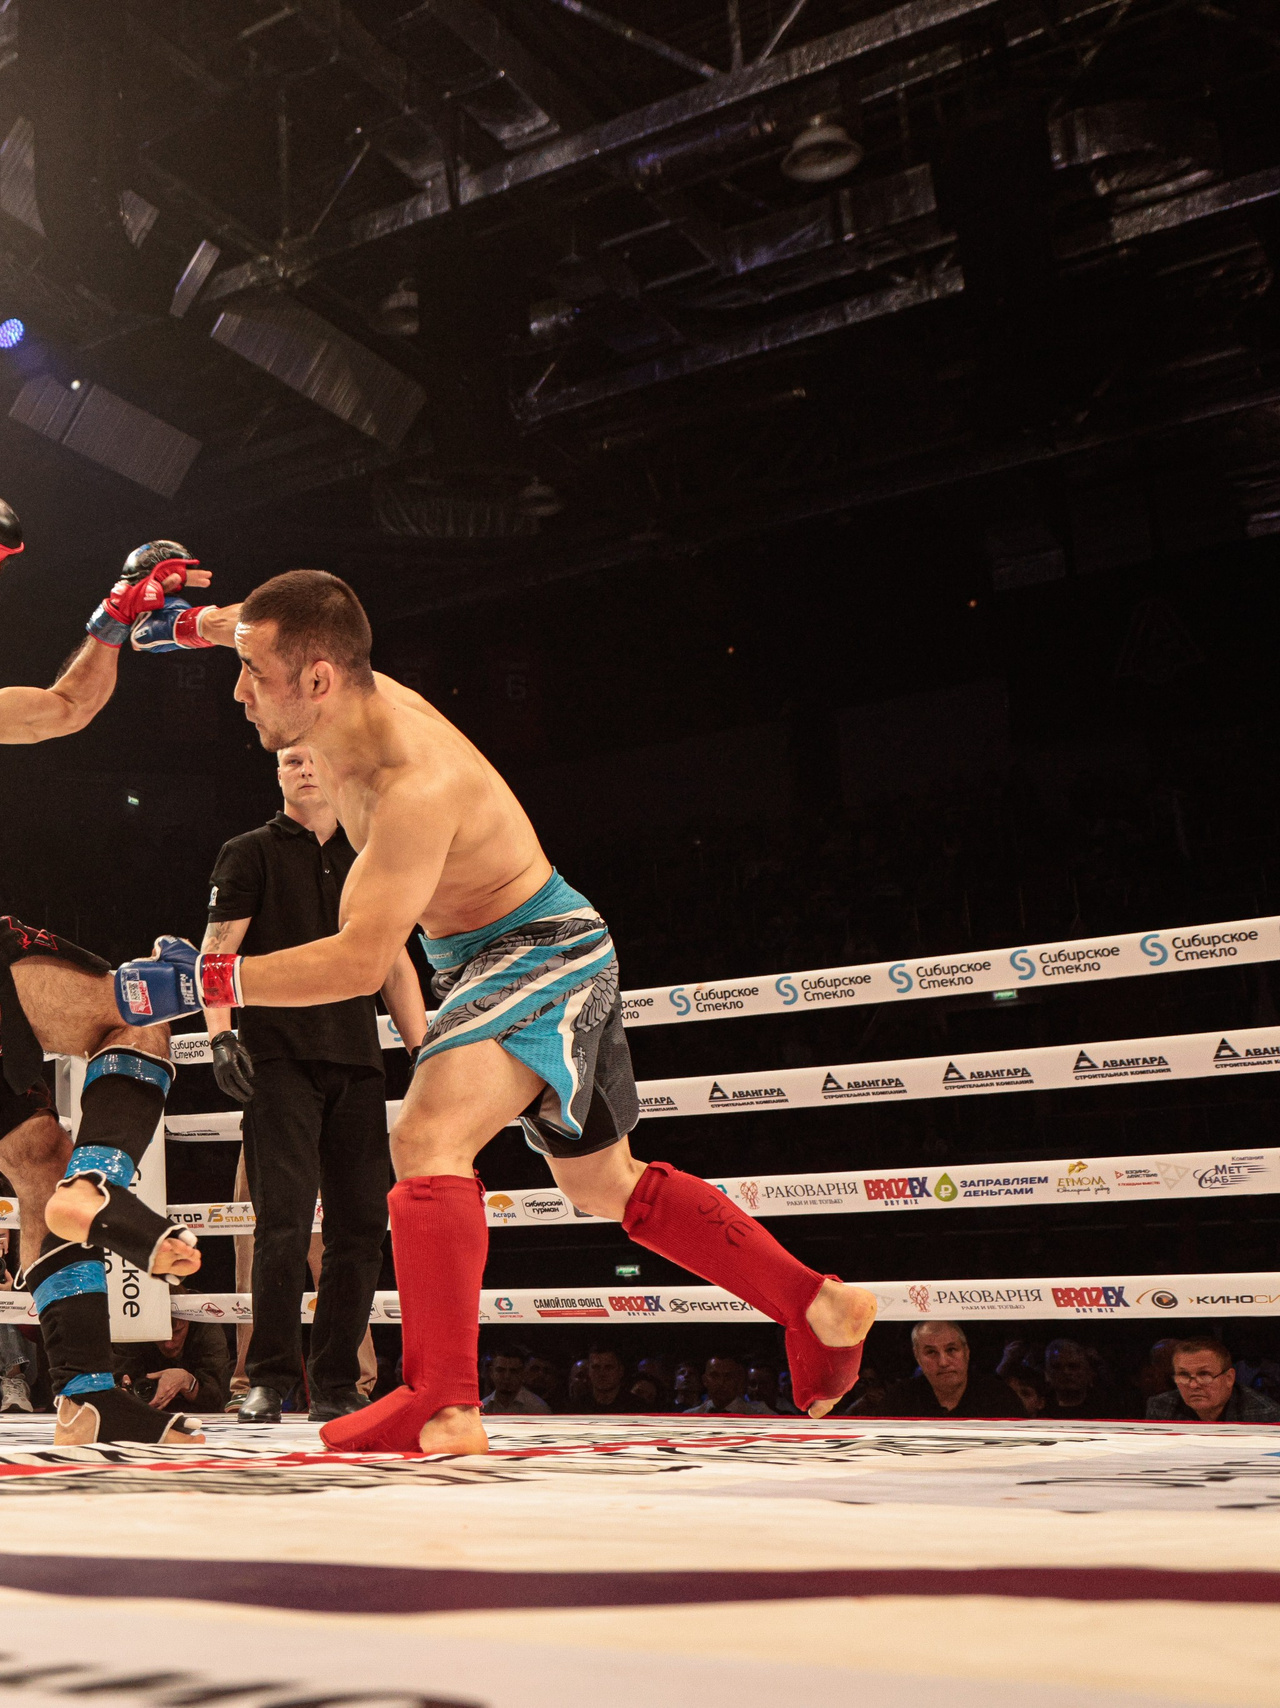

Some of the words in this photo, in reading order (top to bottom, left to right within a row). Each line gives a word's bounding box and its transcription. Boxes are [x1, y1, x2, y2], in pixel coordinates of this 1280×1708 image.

[1172, 930, 1258, 950] Сибирское
[1040, 945, 1120, 965] Сибирское
[1174, 944, 1237, 963] Стекло
[916, 960, 992, 979] Сибирское
[1042, 960, 1100, 977] Стекло
[801, 974, 871, 992] Сибирское
[919, 974, 974, 990] Стекло
[693, 986, 759, 1003] Сибирское
[804, 988, 855, 1002] Стекло
[696, 1000, 744, 1013] Стекло
[171, 1040, 212, 1050] Сибирско
[175, 1050, 204, 1059] Стекло
[1102, 1056, 1169, 1068] АВАНГАРД
[970, 1067, 1031, 1079] АВАНГАРД
[847, 1078, 905, 1089] АВАНГАРД
[732, 1088, 786, 1099] АВАНГАРД
[863, 1176, 932, 1201] BROZEX
[960, 1176, 1049, 1188] ЗАПРАВЛЯЕМ
[765, 1182, 858, 1199] РАКОВАРНЯ
[963, 1187, 1034, 1197] ДЕНЬГАМИ
[534, 1297, 577, 1308] САМОЙЛОВ
[578, 1298, 604, 1308] ФОНД
[937, 1289, 1043, 1304] РАКОВАРНЯ
[1051, 1286, 1130, 1308] BROZEX
[1197, 1294, 1280, 1305] КИНОСИ
[609, 1296, 666, 1312] BROZEX
[690, 1301, 754, 1312] FIGHTEX
